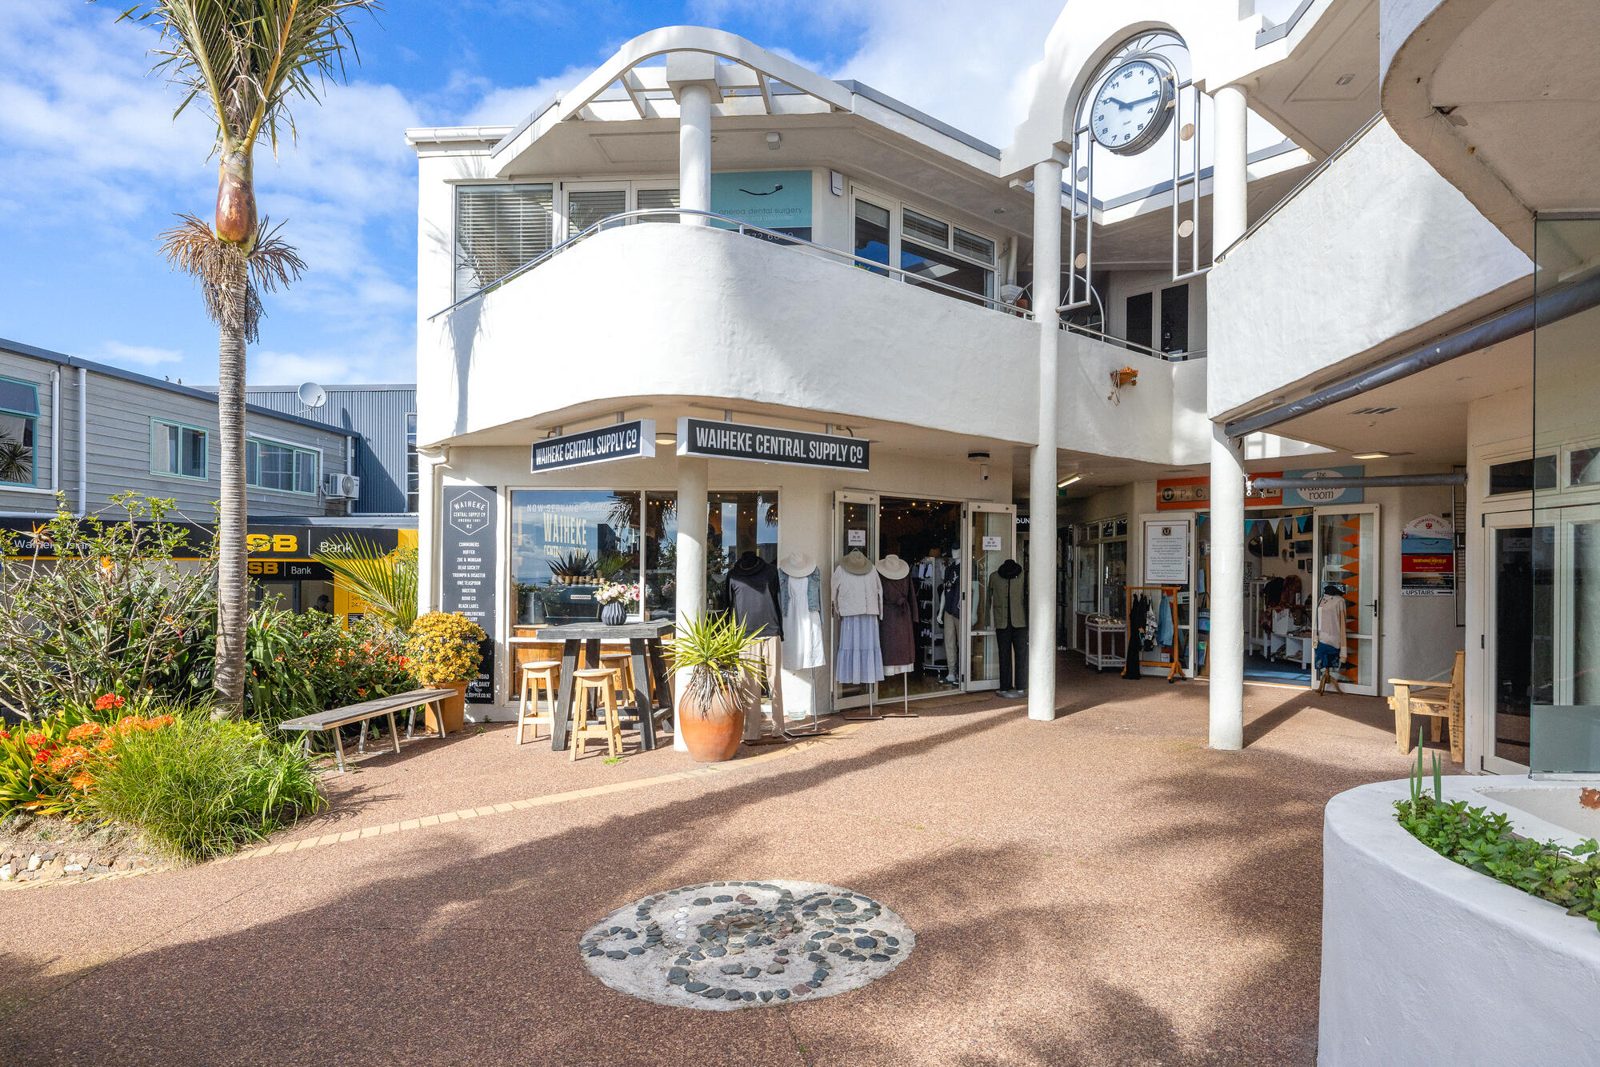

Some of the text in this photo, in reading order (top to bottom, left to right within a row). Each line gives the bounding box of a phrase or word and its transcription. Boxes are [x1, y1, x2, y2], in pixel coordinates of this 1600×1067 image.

[1123, 71, 1133, 79] 12
[1148, 77, 1155, 85] 2
[1098, 114, 1105, 122] 9
[1102, 127, 1108, 135] 8
[1137, 123, 1144, 131] 5
[1124, 133, 1131, 141] 6
[718, 207, 803, 217] oneroa dental surgery
[536, 443, 564, 466] WAIHEKE
[564, 437, 596, 461] CENTRAL
[596, 430, 625, 455] SUPPLY
[696, 426, 753, 453] WAIHEKE
[755, 434, 807, 459] CENTRAL
[809, 440, 848, 462] SUPPLY
[1309, 491, 1334, 500] room
[453, 500, 486, 511] WAIHEKE
[526, 504, 544, 513] NOW
[546, 504, 579, 513] SERVING
[543, 513, 587, 545] WAIHEKE
[246, 534, 353, 554] SB Bank
[248, 562, 312, 575] SB Bank
